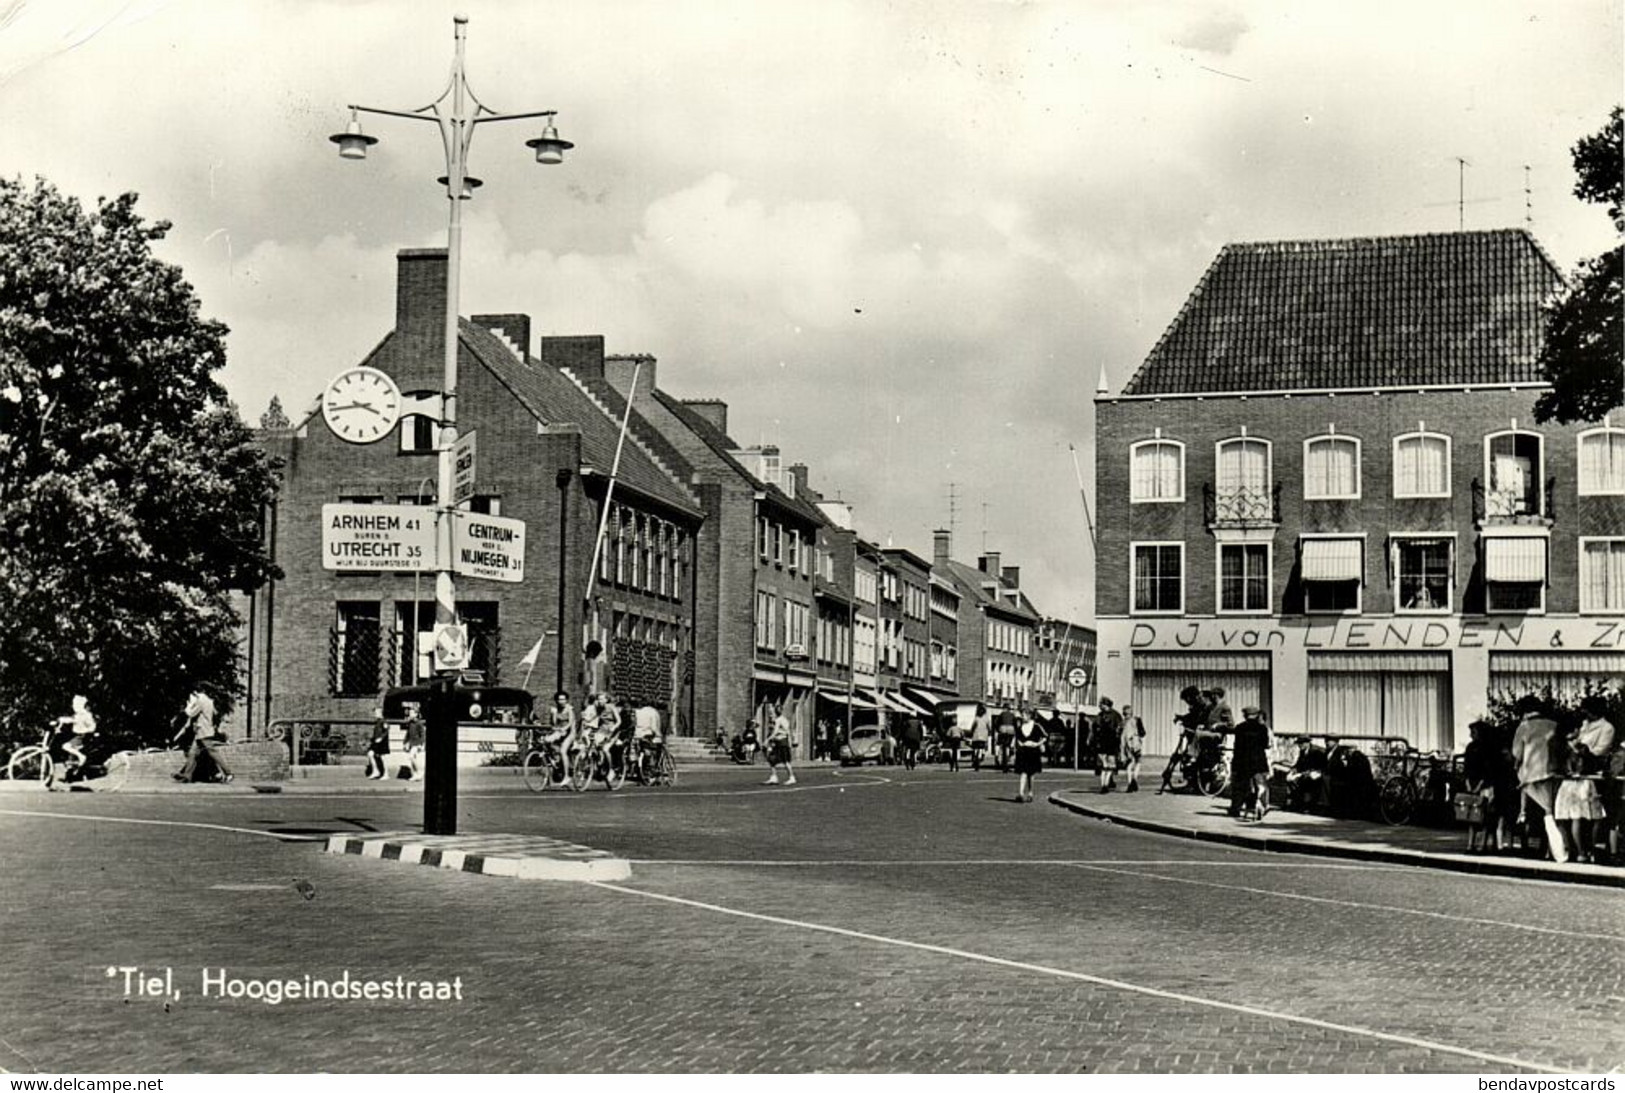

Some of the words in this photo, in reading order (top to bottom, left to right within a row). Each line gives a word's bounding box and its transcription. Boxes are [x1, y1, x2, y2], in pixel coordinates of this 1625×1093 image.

[331, 514, 400, 530] ARNHEM
[405, 519, 421, 531] 41
[330, 541, 401, 557] UTRECHT
[406, 545, 422, 558] 35
[460, 548, 510, 569] NIJMEGEN
[512, 558, 522, 571] 31
[1302, 622, 1525, 648] LIENDEN
[1549, 629, 1563, 647] &
